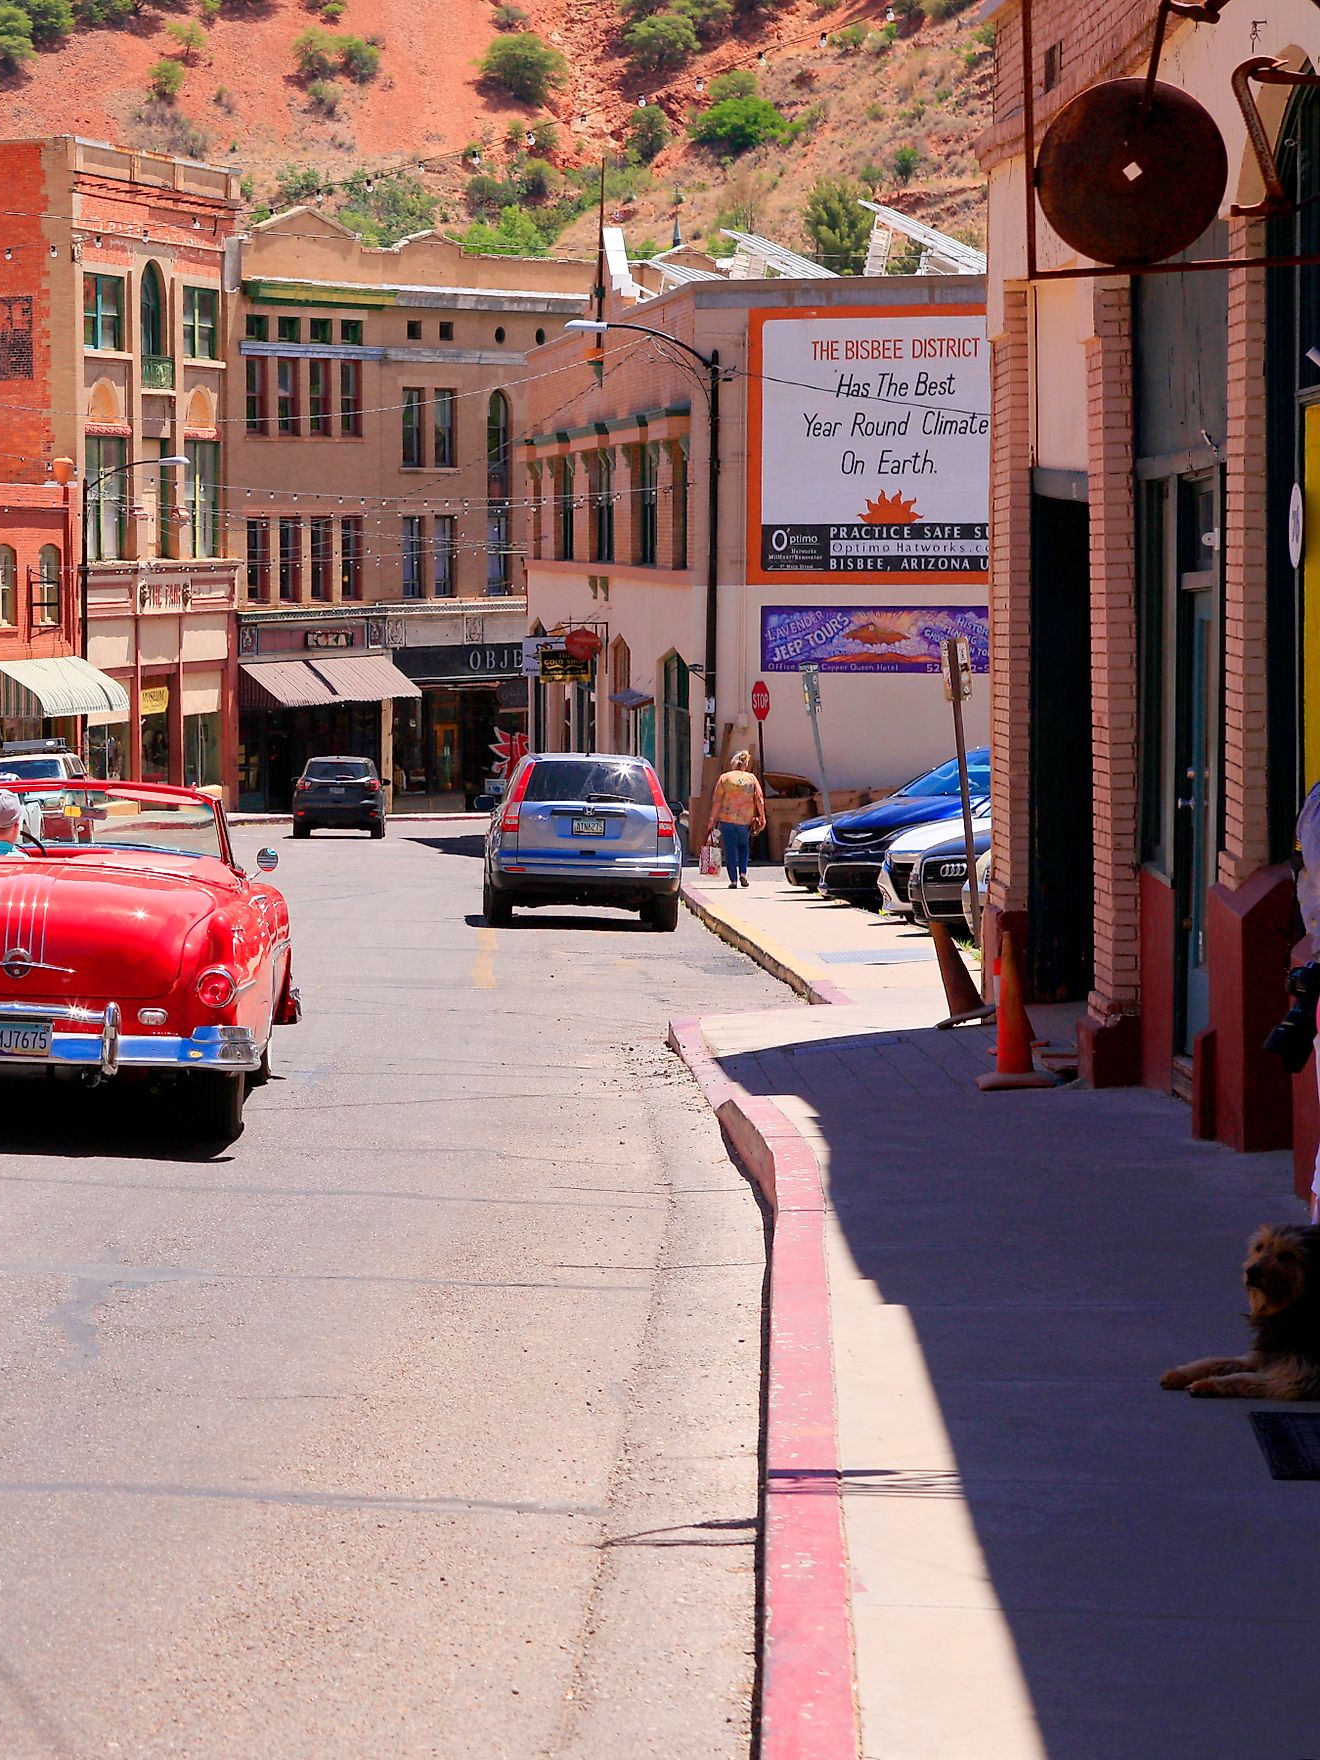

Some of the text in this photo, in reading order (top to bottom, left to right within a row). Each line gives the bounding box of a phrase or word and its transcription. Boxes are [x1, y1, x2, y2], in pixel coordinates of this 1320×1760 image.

[812, 337, 980, 361] THE BISBEE DISTRICT
[836, 372, 955, 397] Has The Best
[803, 410, 989, 437] Year Round Climate
[841, 449, 938, 475] On Earth.
[829, 526, 911, 538] PRACTICE
[924, 526, 961, 538] SAFE
[832, 542, 890, 556] Optimo
[829, 558, 891, 571] BISBEE,
[900, 558, 970, 570] ARIZONA
[767, 610, 824, 641] LAVENDER
[773, 613, 850, 662] JEEP TOURS
[850, 663, 874, 671] Queen
[877, 663, 899, 671] Hotel
[752, 693, 769, 709] STOP
